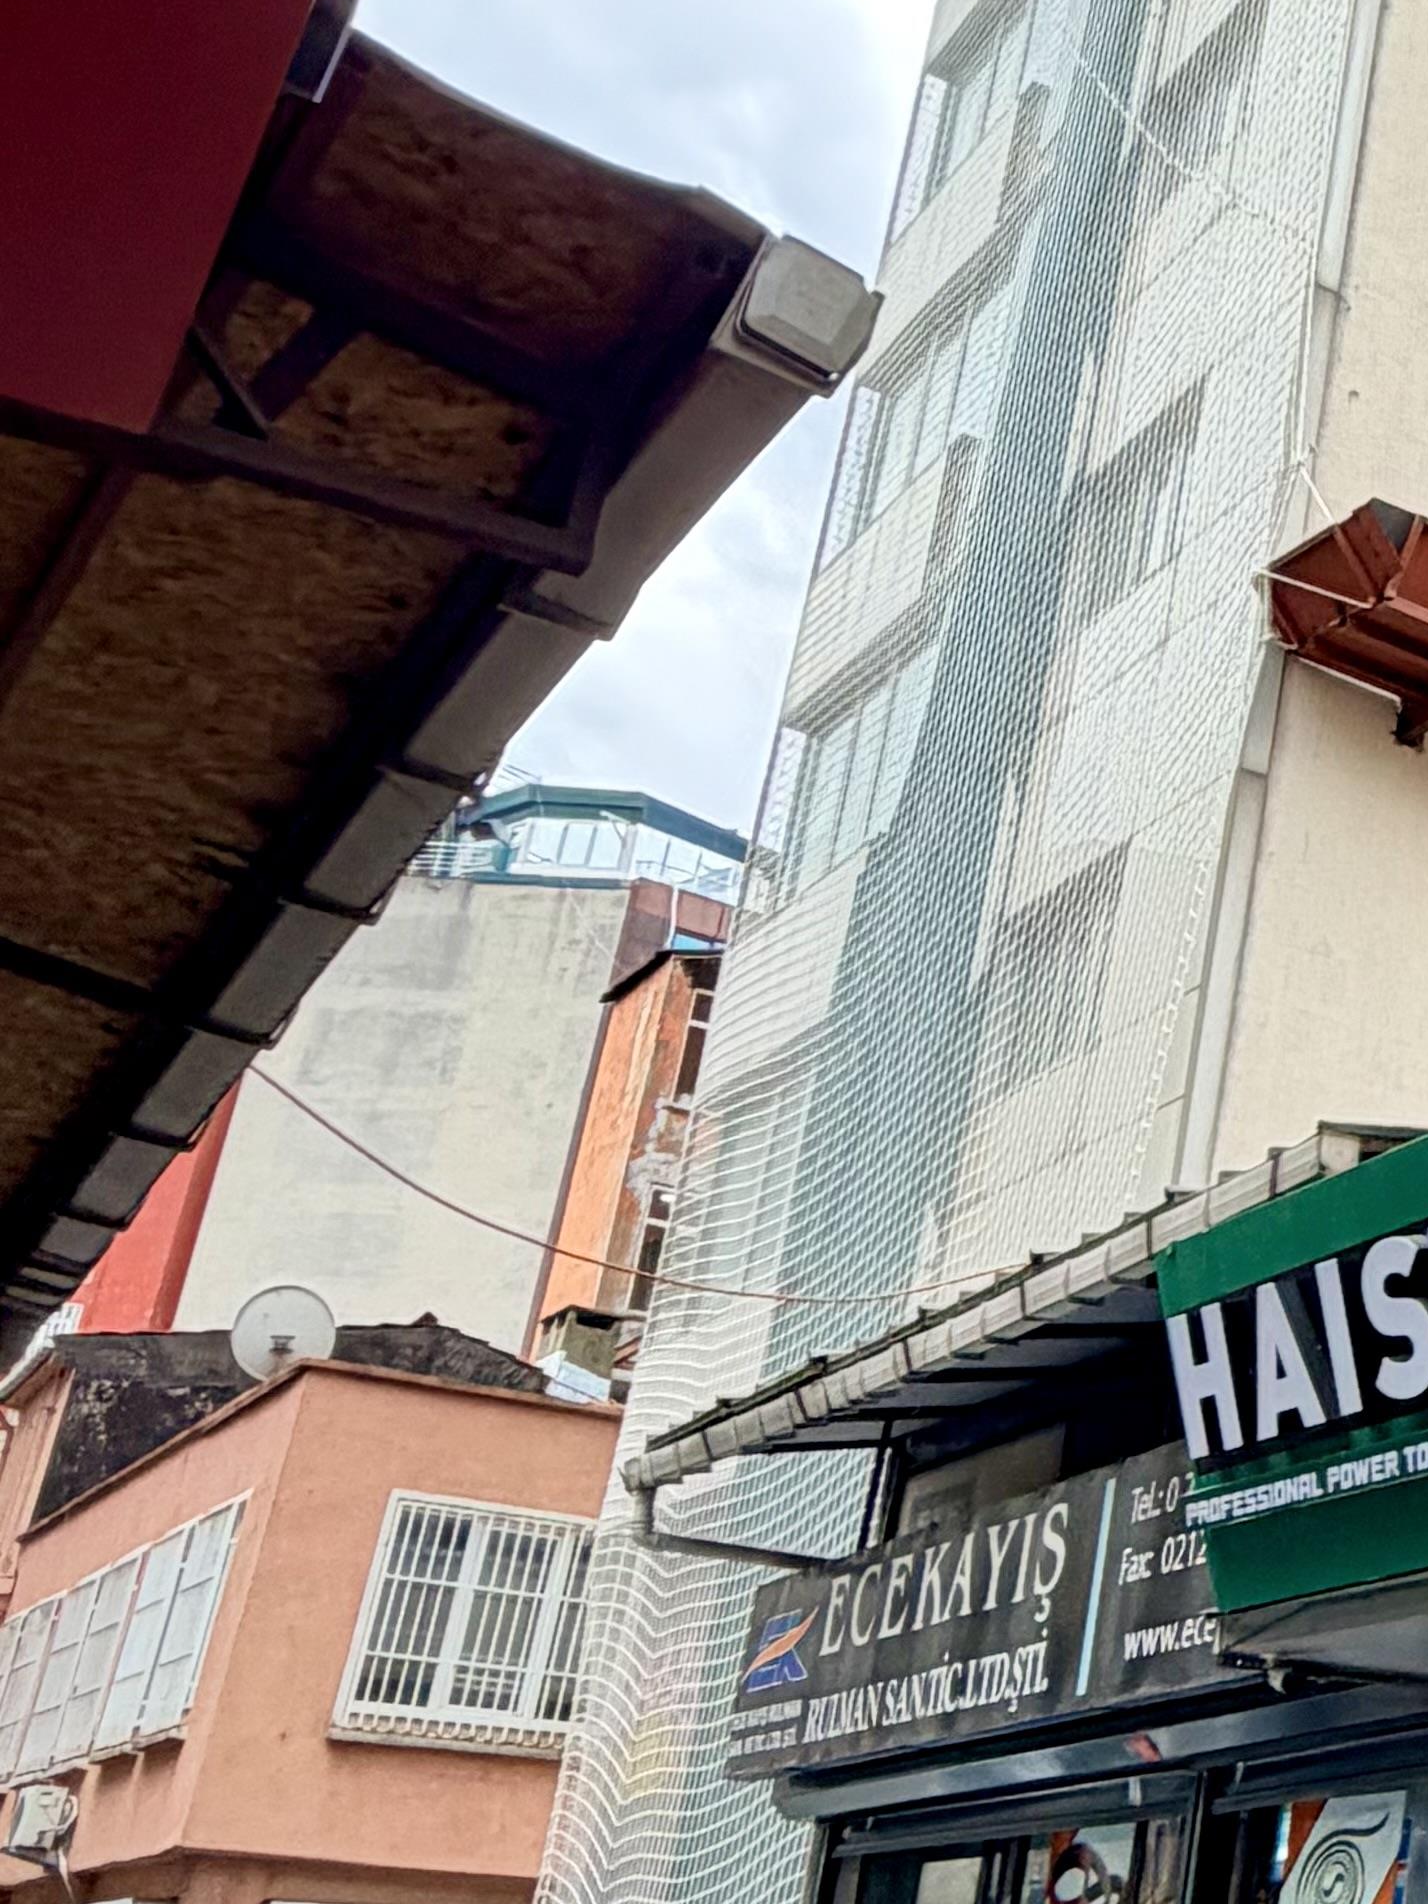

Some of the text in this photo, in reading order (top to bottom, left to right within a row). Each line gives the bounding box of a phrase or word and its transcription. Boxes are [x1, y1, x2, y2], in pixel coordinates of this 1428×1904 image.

[1185, 1472, 1324, 1527] PROFESSIONAL
[1327, 1449, 1400, 1493] POWER
[802, 1681, 884, 1744] RULMAN
